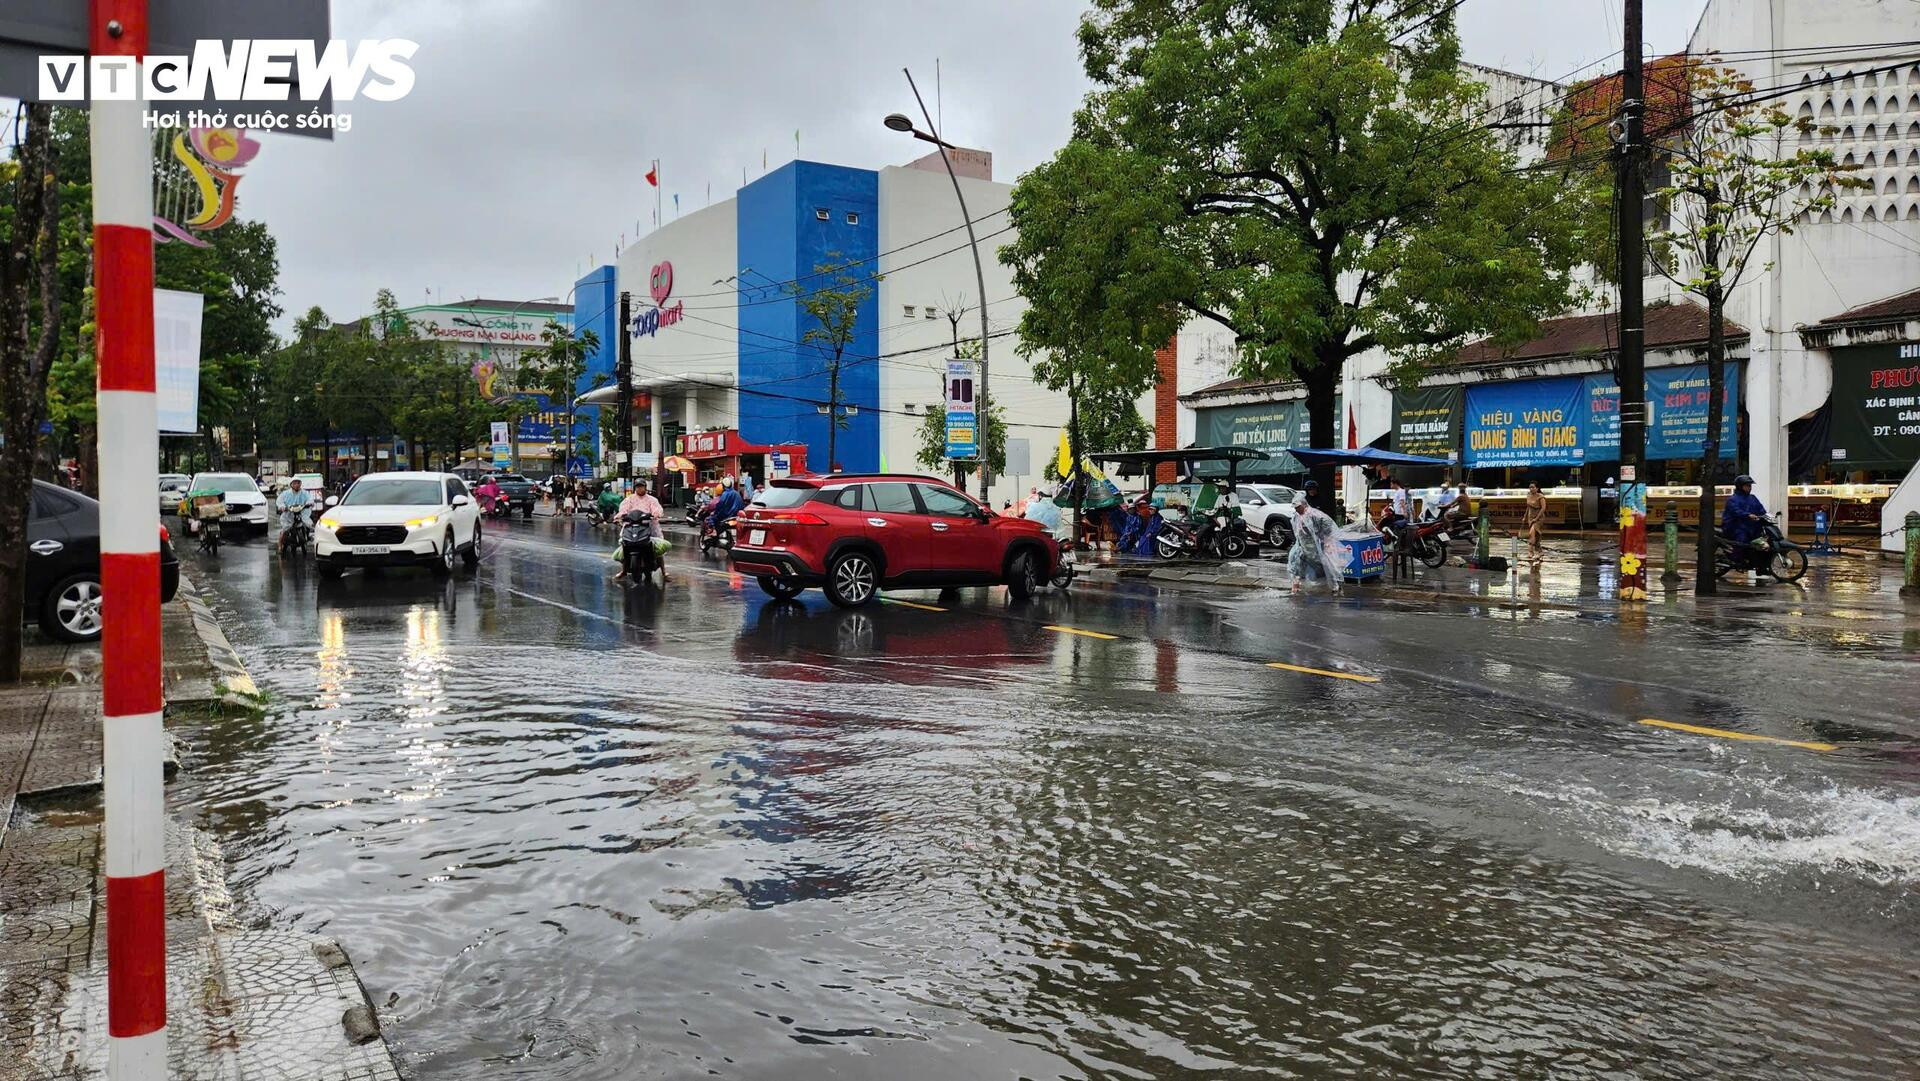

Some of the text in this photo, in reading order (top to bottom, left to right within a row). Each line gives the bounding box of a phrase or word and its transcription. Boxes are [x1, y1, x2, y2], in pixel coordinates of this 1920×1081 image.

[1900, 344, 1920, 358] HI
[1866, 397, 1886, 408] XÁC
[1889, 396, 1914, 408] ĐỊNH
[1481, 408, 1562, 428] HIỆU VÀNG
[1470, 428, 1507, 451] QUANG
[1511, 424, 1537, 449] BÌNH
[1542, 426, 1577, 448] GIANG
